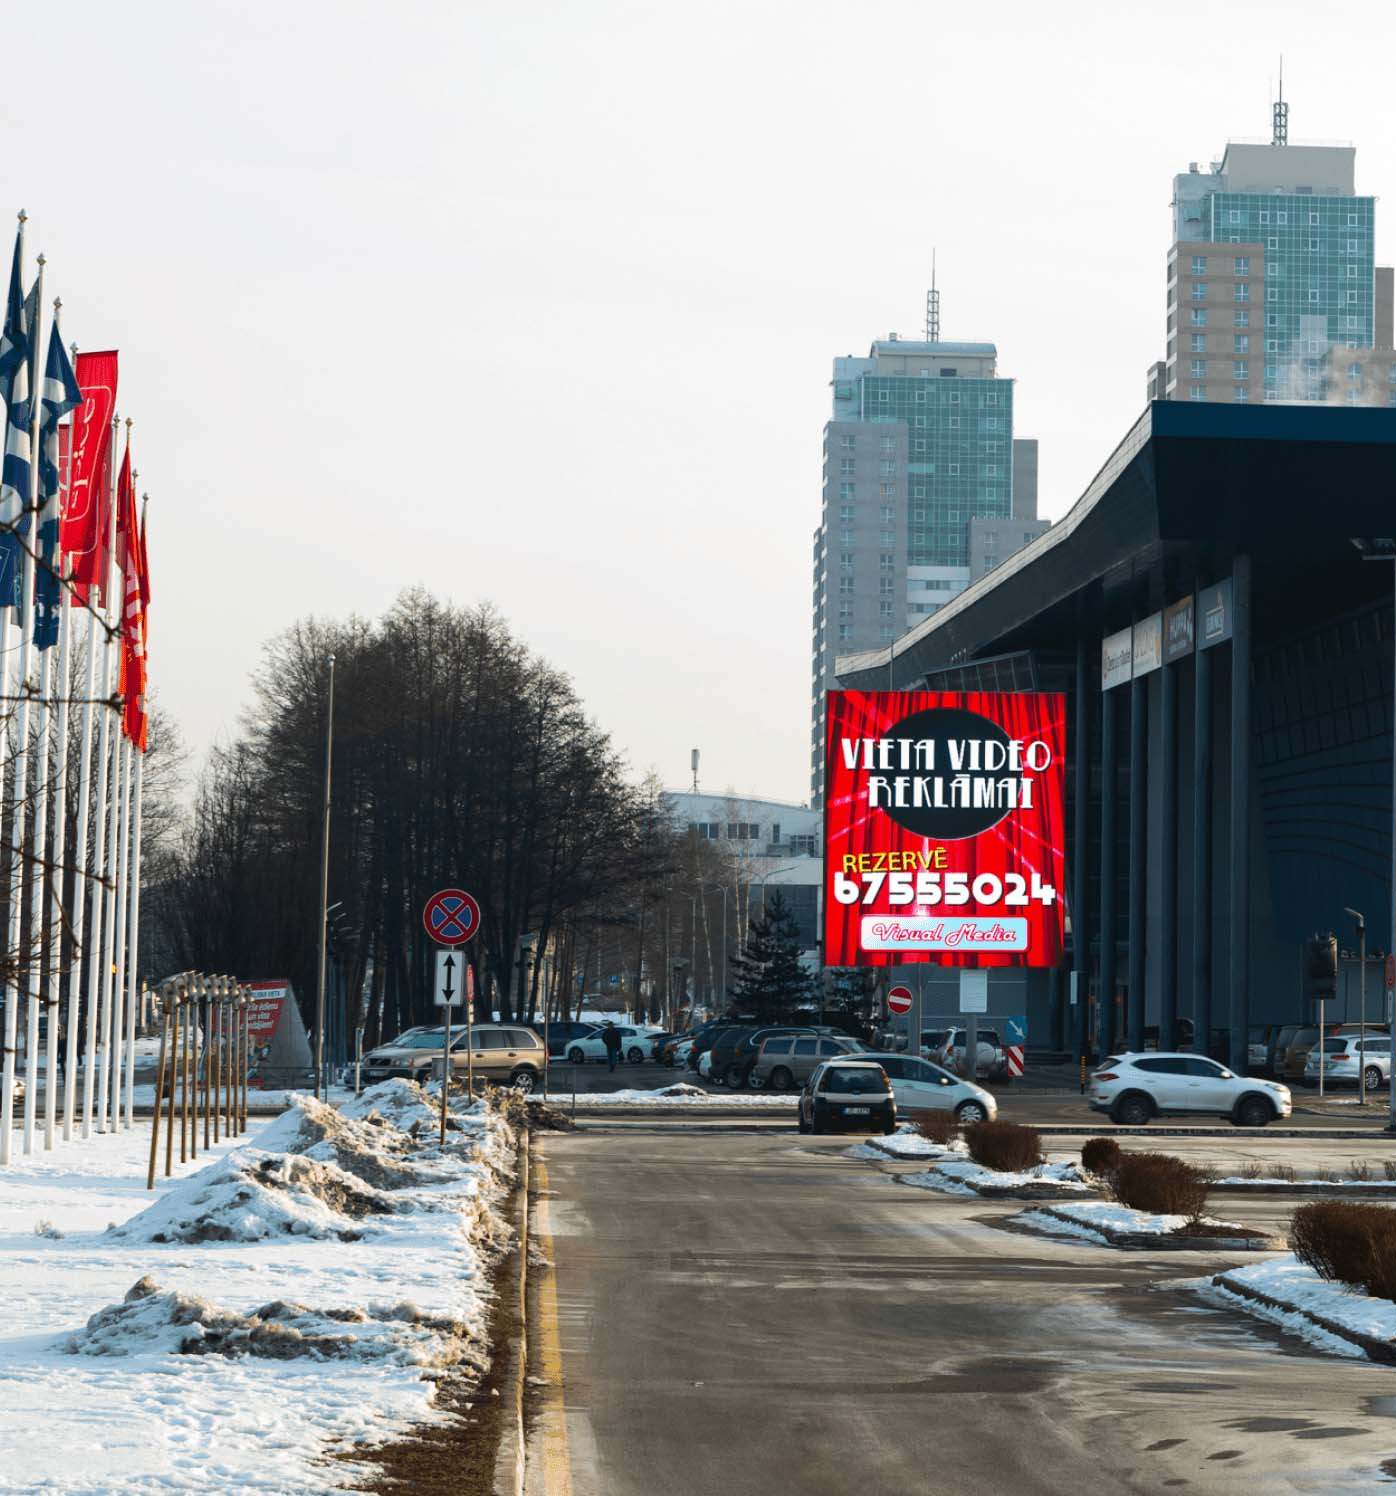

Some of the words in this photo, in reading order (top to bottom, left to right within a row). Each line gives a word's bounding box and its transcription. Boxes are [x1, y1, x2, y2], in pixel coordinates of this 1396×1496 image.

[841, 737, 936, 770] VIETA
[948, 738, 1051, 772] VIDEO
[867, 773, 1034, 809] REKLĀMAI
[843, 847, 949, 873] REZERVĒ
[834, 871, 1056, 906] 67555024
[872, 923, 945, 942] Visual
[945, 924, 1017, 946] Media
